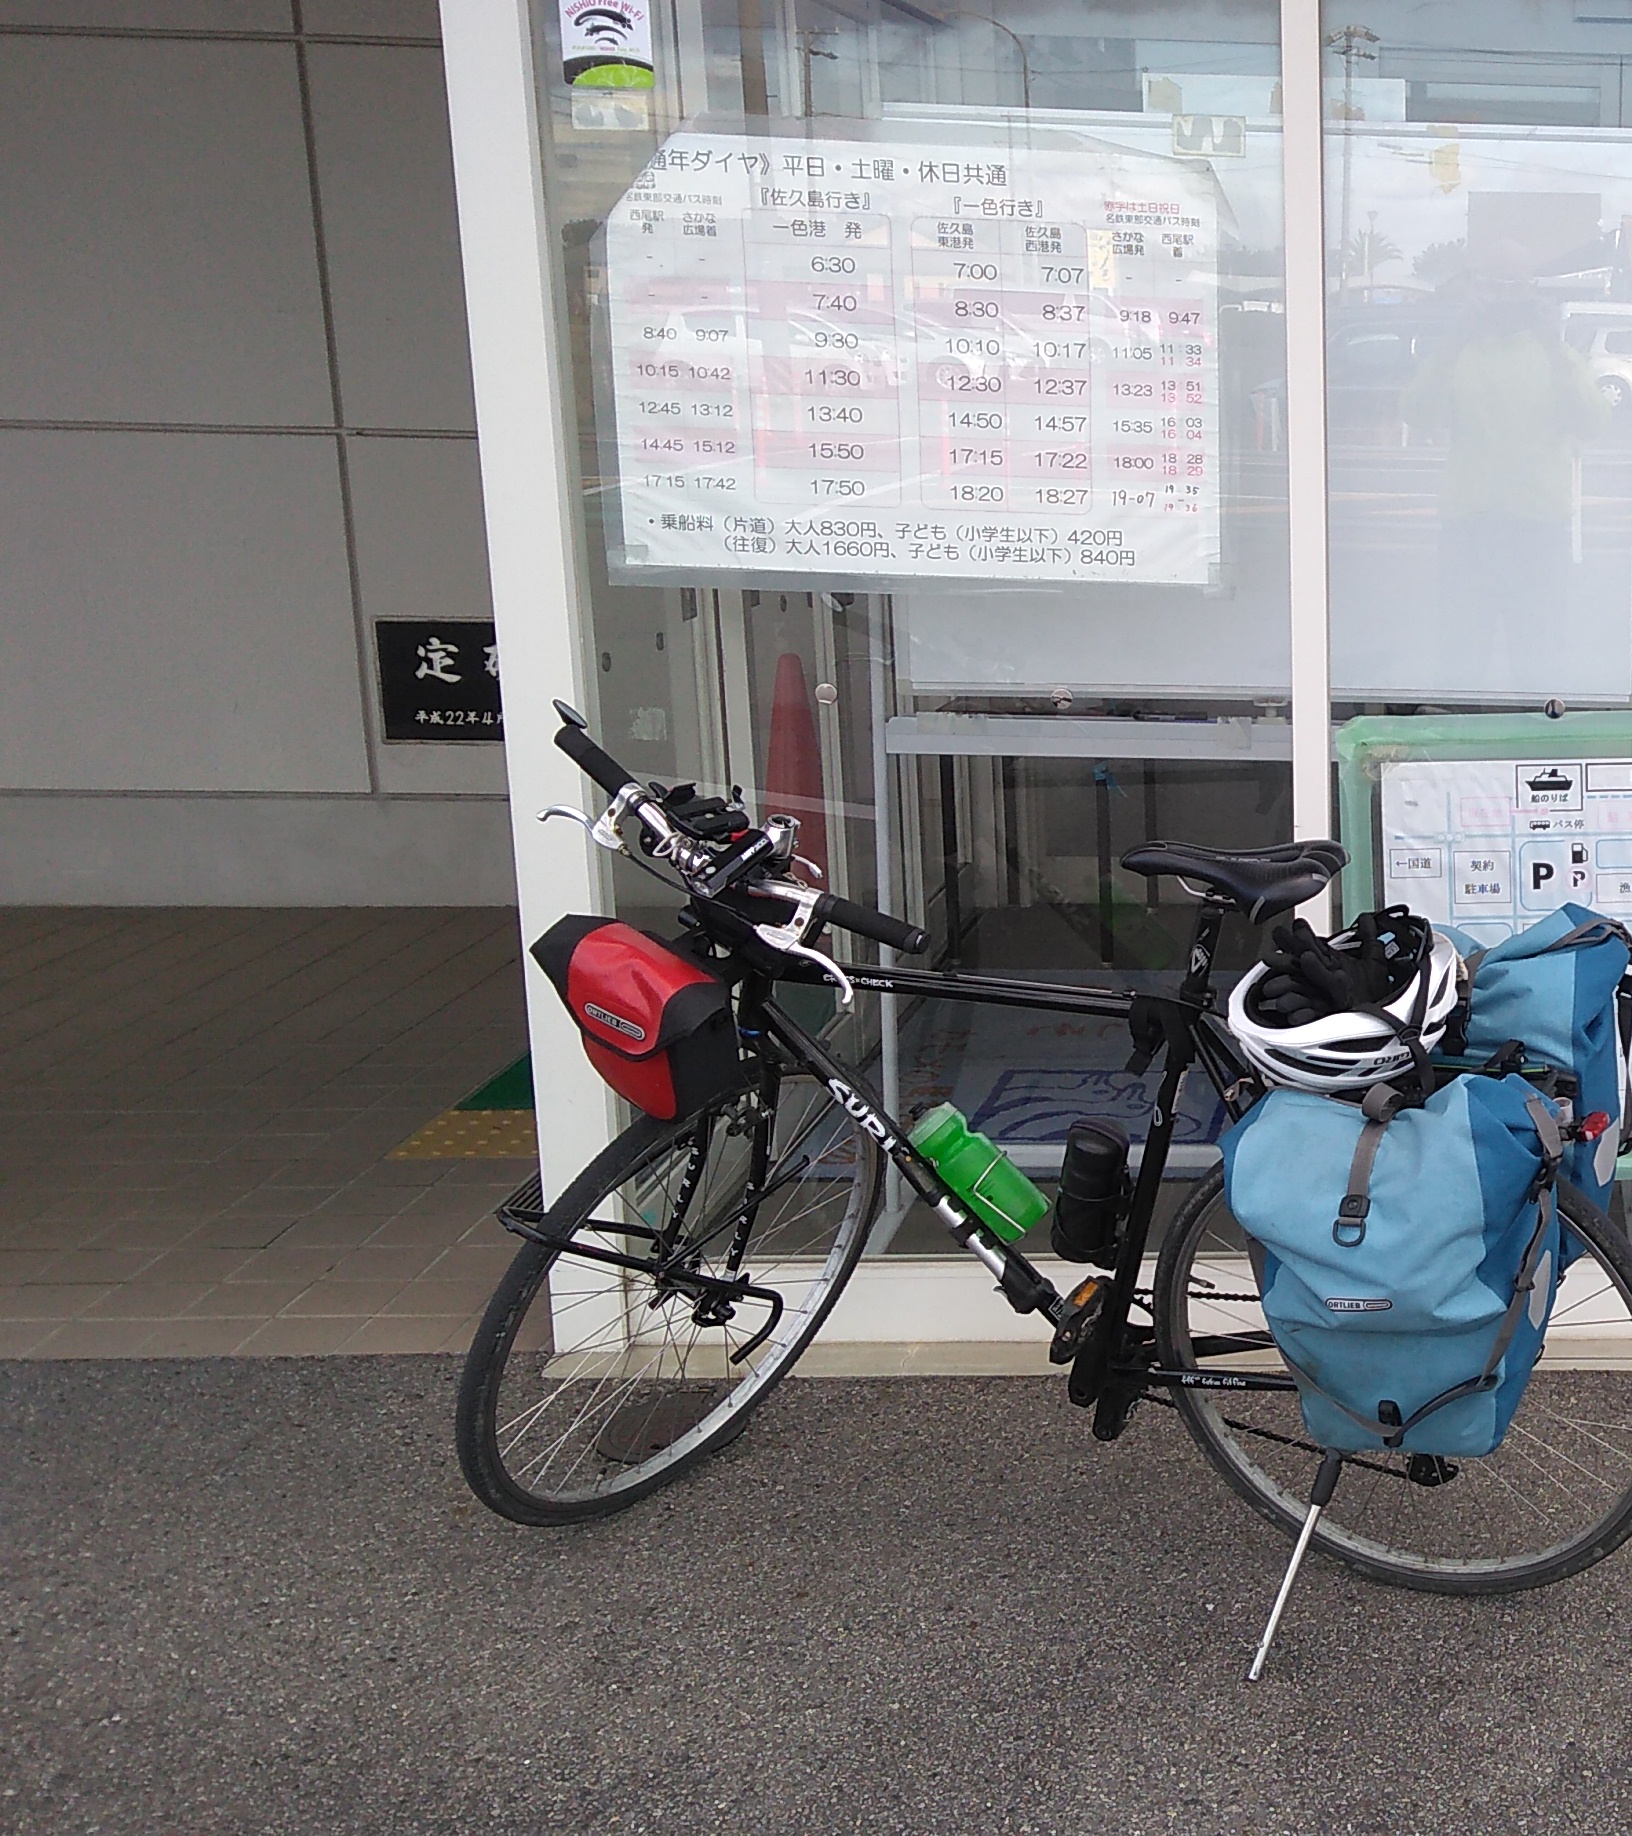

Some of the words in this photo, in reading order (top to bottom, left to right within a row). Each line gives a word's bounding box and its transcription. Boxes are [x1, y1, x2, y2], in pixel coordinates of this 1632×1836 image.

[565, 0, 596, 18] NISHIO
[598, 0, 619, 8] Free
[621, 1, 644, 21] Wi-Fi
[760, 188, 871, 210] 『佐久島行き』
[954, 197, 1043, 218] 『一色行き』
[630, 209, 664, 221] 西尾駅
[683, 212, 716, 223] さかな
[1106, 214, 1200, 227] 名鉄東部交通バス時刻
[642, 223, 653, 233] 発
[773, 219, 826, 238] 一色港
[845, 221, 862, 239] 発
[937, 222, 974, 236] 佐久島
[1025, 226, 1061, 239] 佐久島
[937, 236, 974, 250] 東港発
[1112, 232, 1144, 243] さかな
[1162, 234, 1194, 245] 西尾駅
[1025, 240, 1062, 254] 西港発
[1113, 244, 1144, 256] 広場発
[811, 257, 855, 273] 6:30
[954, 263, 997, 280] 7:00
[1041, 266, 1084, 284] 7:07
[812, 295, 857, 311] 7:40
[955, 301, 998, 318] 8:30
[1043, 304, 1085, 322] 8:37
[1120, 310, 1151, 323] 9:18
[643, 327, 677, 340] 8:40
[696, 329, 728, 342] 9:07
[814, 331, 858, 349] 9:30
[946, 338, 1000, 355] 10:10
[1033, 342, 1086, 359] 10:17
[1113, 347, 1152, 360] 11:05
[637, 364, 679, 377] 10:15
[689, 367, 731, 380] 10:42
[804, 370, 861, 386] 11:30
[947, 375, 1001, 392] 12:30
[1034, 379, 1087, 396] 12:37
[1114, 384, 1153, 396] 13:23
[639, 402, 681, 414] 12:45
[691, 404, 733, 417] 13:12
[807, 406, 863, 423] 13:40
[949, 412, 1002, 429] 14:50
[1034, 415, 1087, 433] 14:57
[1113, 421, 1153, 433] 15:35
[808, 443, 864, 459] 15:50
[950, 448, 1003, 466] 17:15
[1034, 452, 1088, 469] 17:22
[1114, 457, 1154, 469] 18:00
[810, 480, 865, 496] 17:50
[950, 484, 1004, 502] 18:20
[1035, 488, 1088, 506] 18:27
[1531, 793, 1569, 804] 船のりば
[1553, 819, 1585, 830] バス停
[1407, 858, 1432, 870] 国道
[1470, 860, 1495, 872] 契約
[1532, 863, 1554, 890] P
[1465, 883, 1501, 895] 駐車場
[587, 1006, 617, 1027] ORTLIEB
[1327, 1301, 1361, 1309] ORTLIEB
